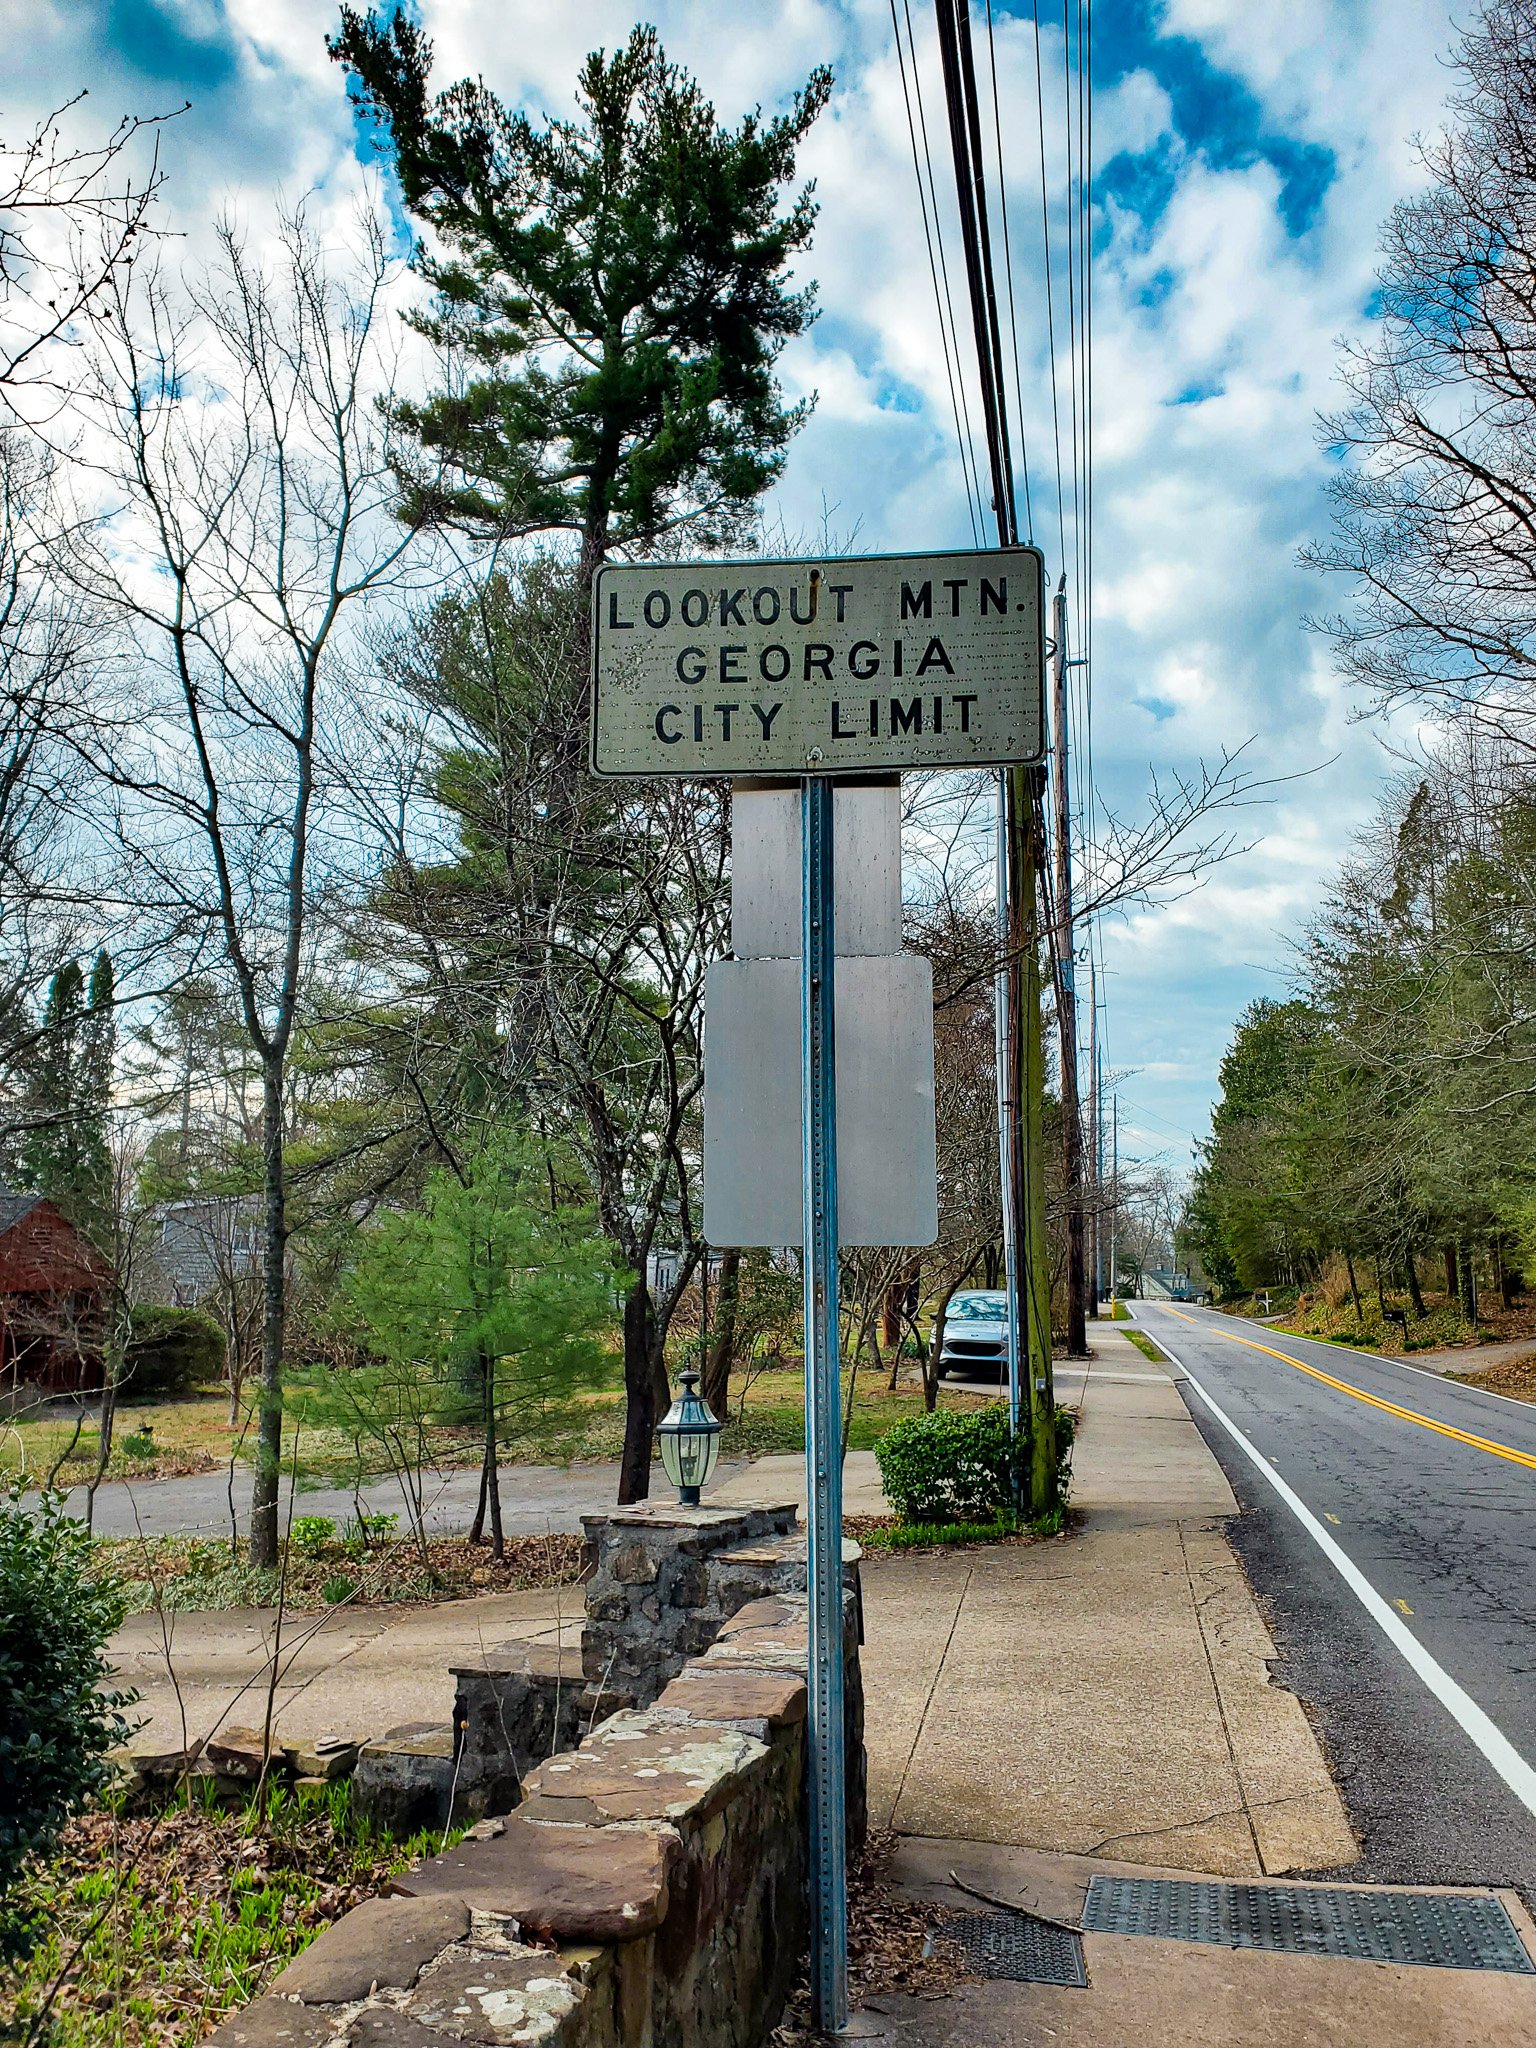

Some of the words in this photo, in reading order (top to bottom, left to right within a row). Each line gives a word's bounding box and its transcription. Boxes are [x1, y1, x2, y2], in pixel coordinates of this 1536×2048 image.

[608, 586, 854, 630] LOOKOUT
[900, 577, 1026, 620] MTN.
[676, 638, 955, 685] GEORGIA
[655, 703, 784, 745] CITY
[831, 694, 978, 740] LIMIT
